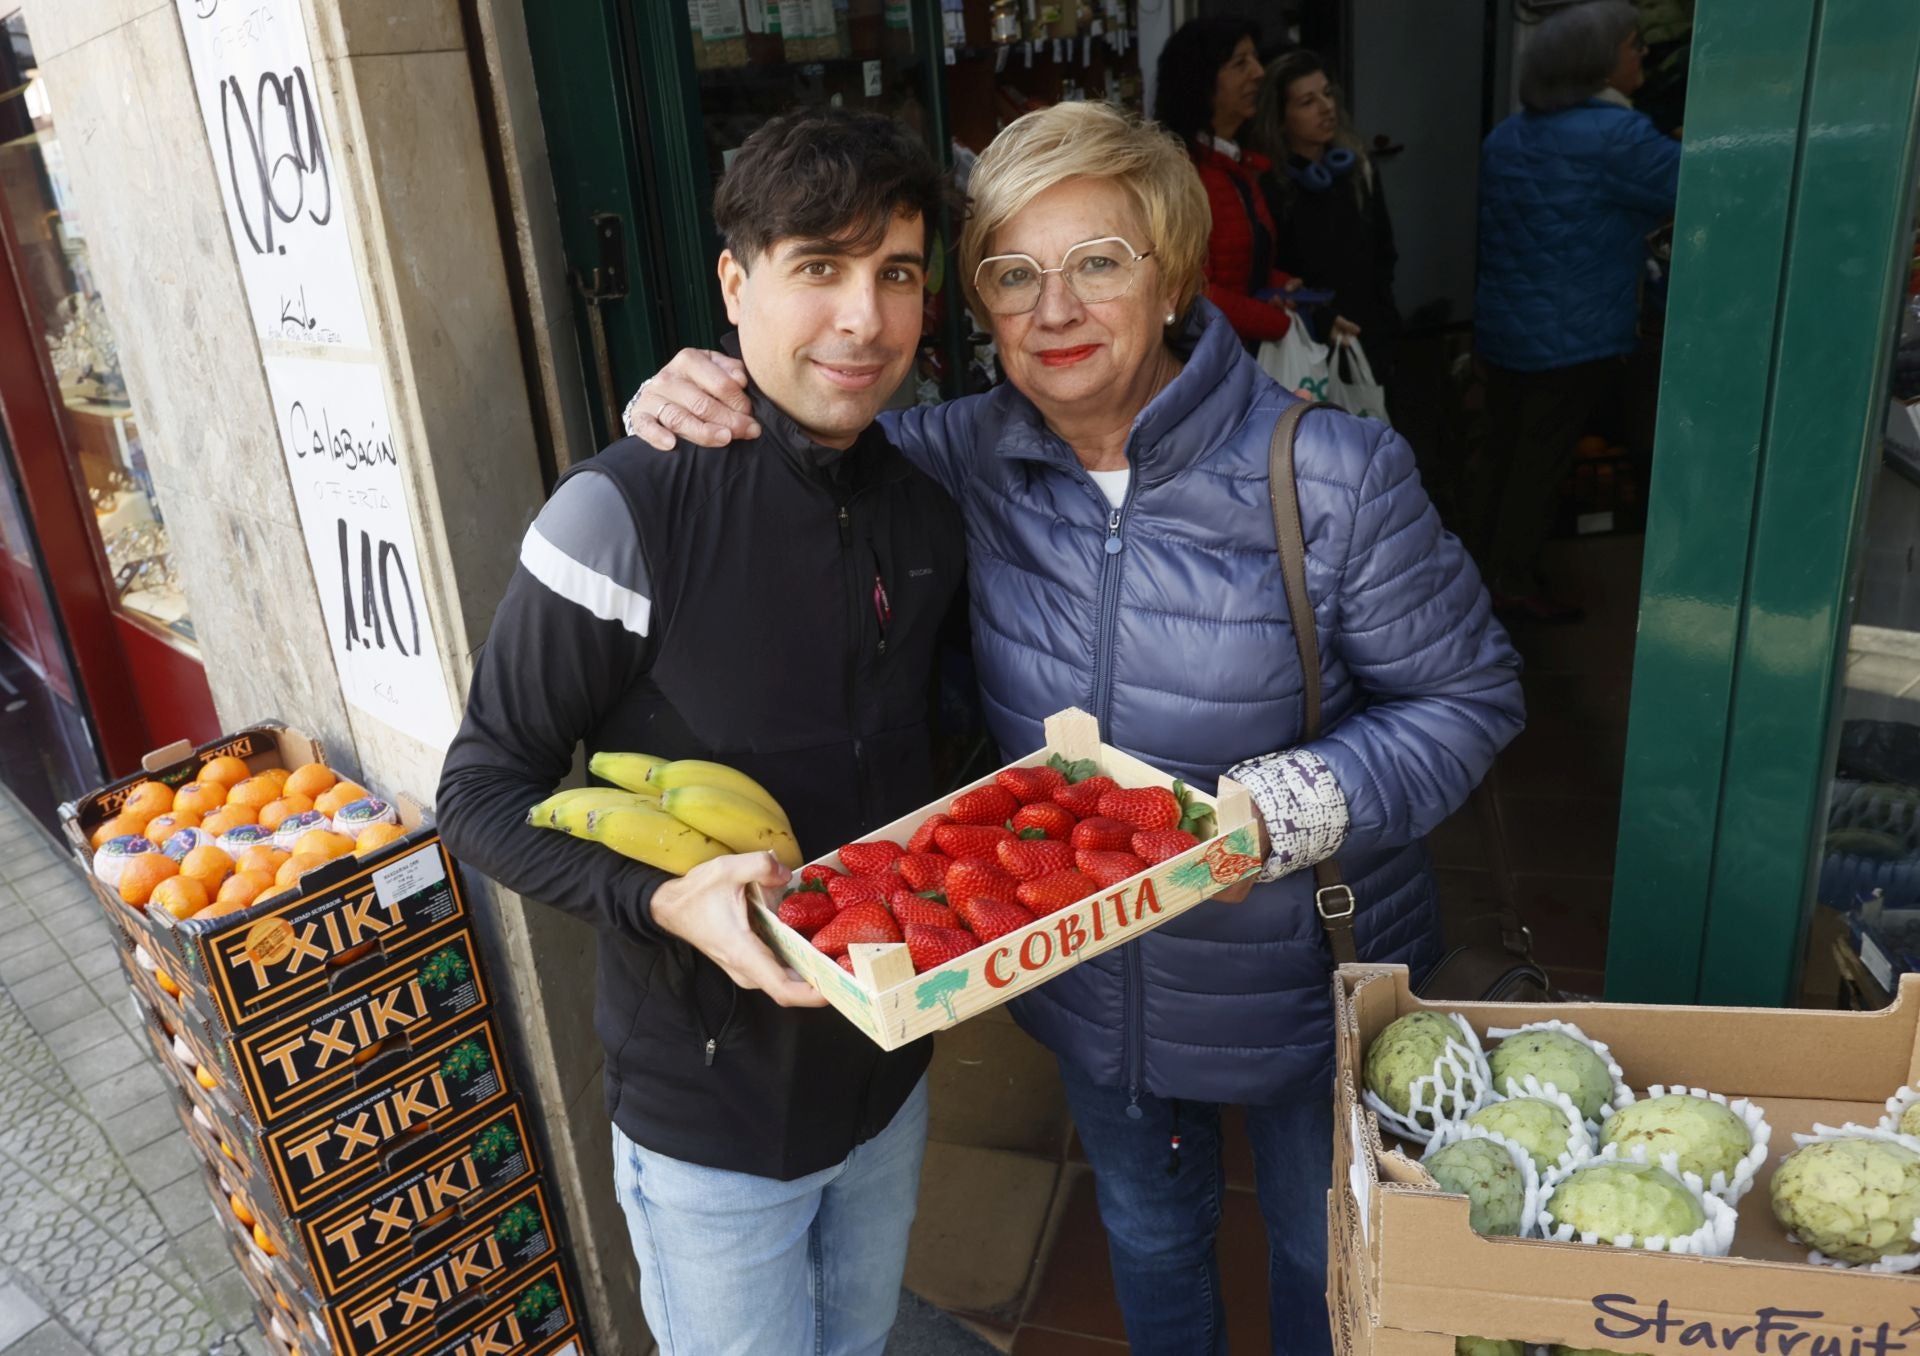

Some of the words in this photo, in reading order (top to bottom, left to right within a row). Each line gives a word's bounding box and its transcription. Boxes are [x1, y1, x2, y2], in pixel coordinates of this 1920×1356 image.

[984, 877, 1164, 989] COBITA
[261, 978, 429, 1086] TXIKI
[310, 1008, 339, 1026] CALIDAD
[338, 993, 368, 1012] SUPERIOR
[287, 1070, 450, 1179] TXIKI
[324, 1153, 481, 1263] TXIKI
[353, 1234, 503, 1344] TXIKI
[1592, 1293, 1907, 1356] StarFruit
